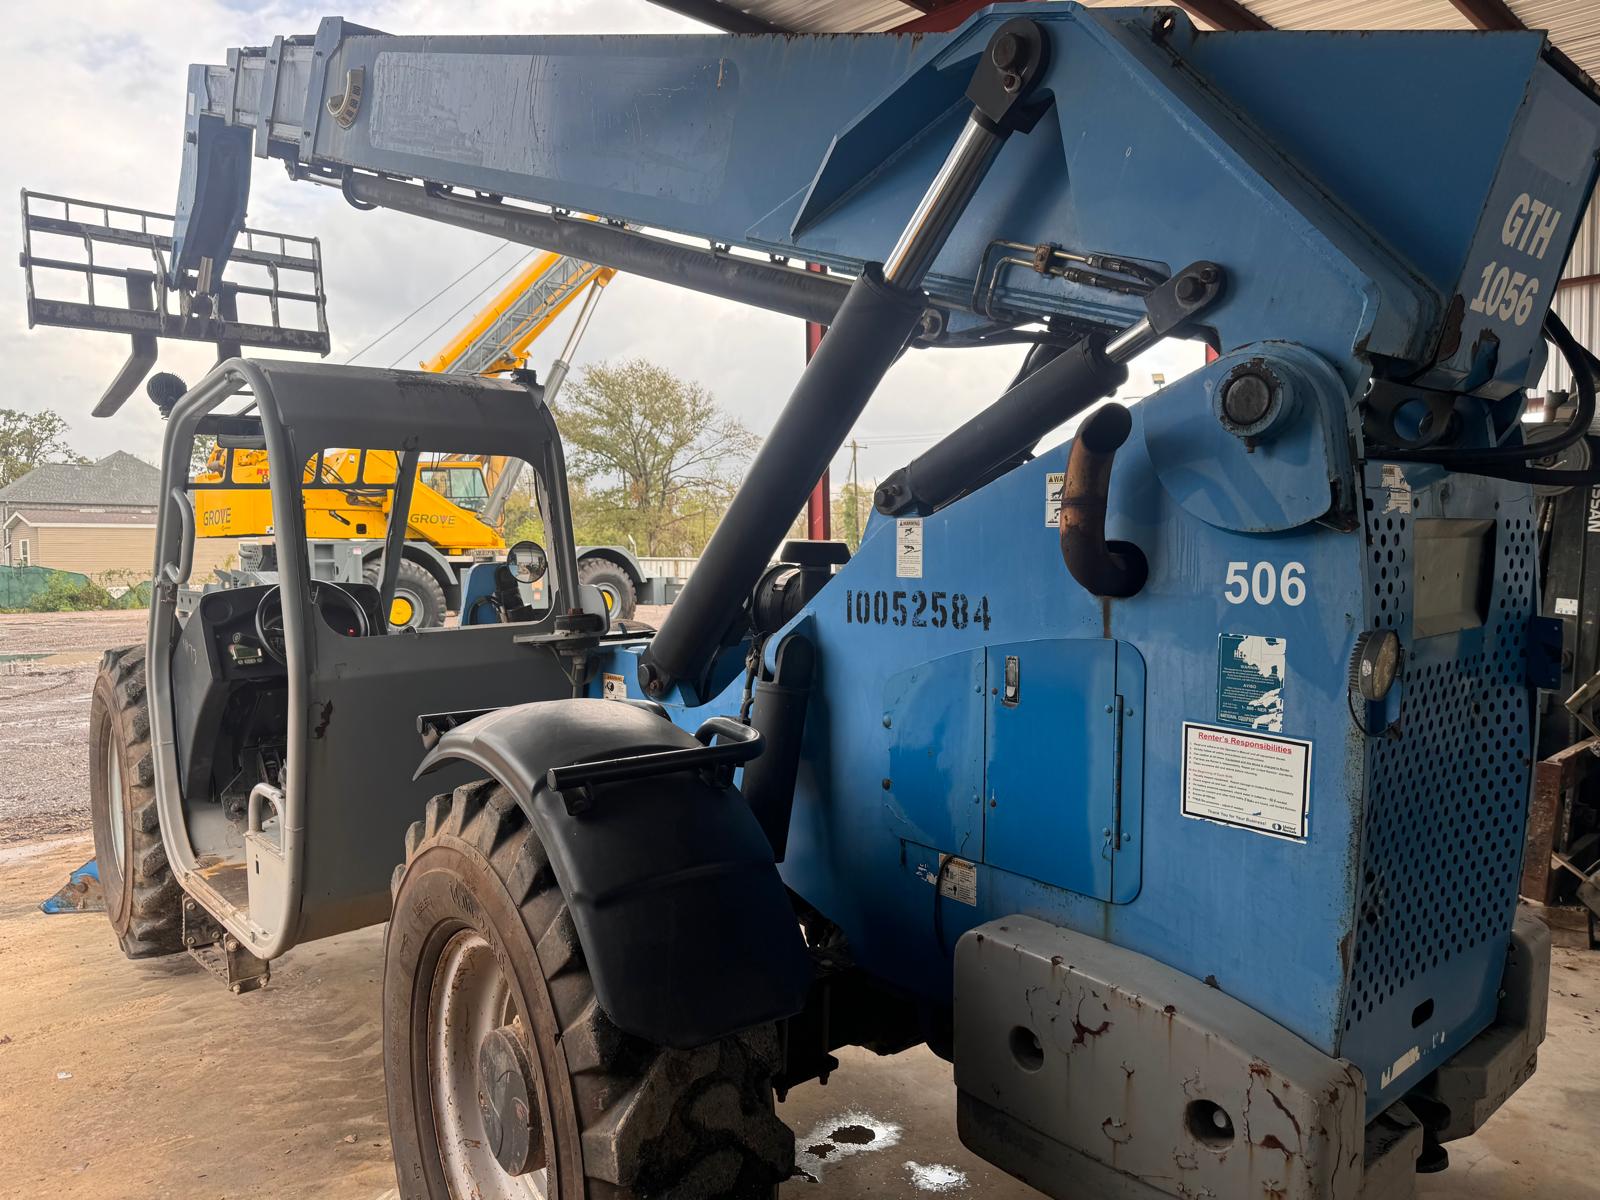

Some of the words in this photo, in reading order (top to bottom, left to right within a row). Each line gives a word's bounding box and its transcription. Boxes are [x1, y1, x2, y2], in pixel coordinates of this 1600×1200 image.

[1502, 193, 1562, 260] GTH
[1469, 261, 1540, 326] 1056
[203, 507, 232, 527] GROVE
[410, 513, 456, 525] GROVE
[1224, 561, 1306, 607] 506
[846, 589, 992, 631] 10052584
[1198, 731, 1229, 744] Renter's
[1230, 737, 1292, 755] Responsibilities
